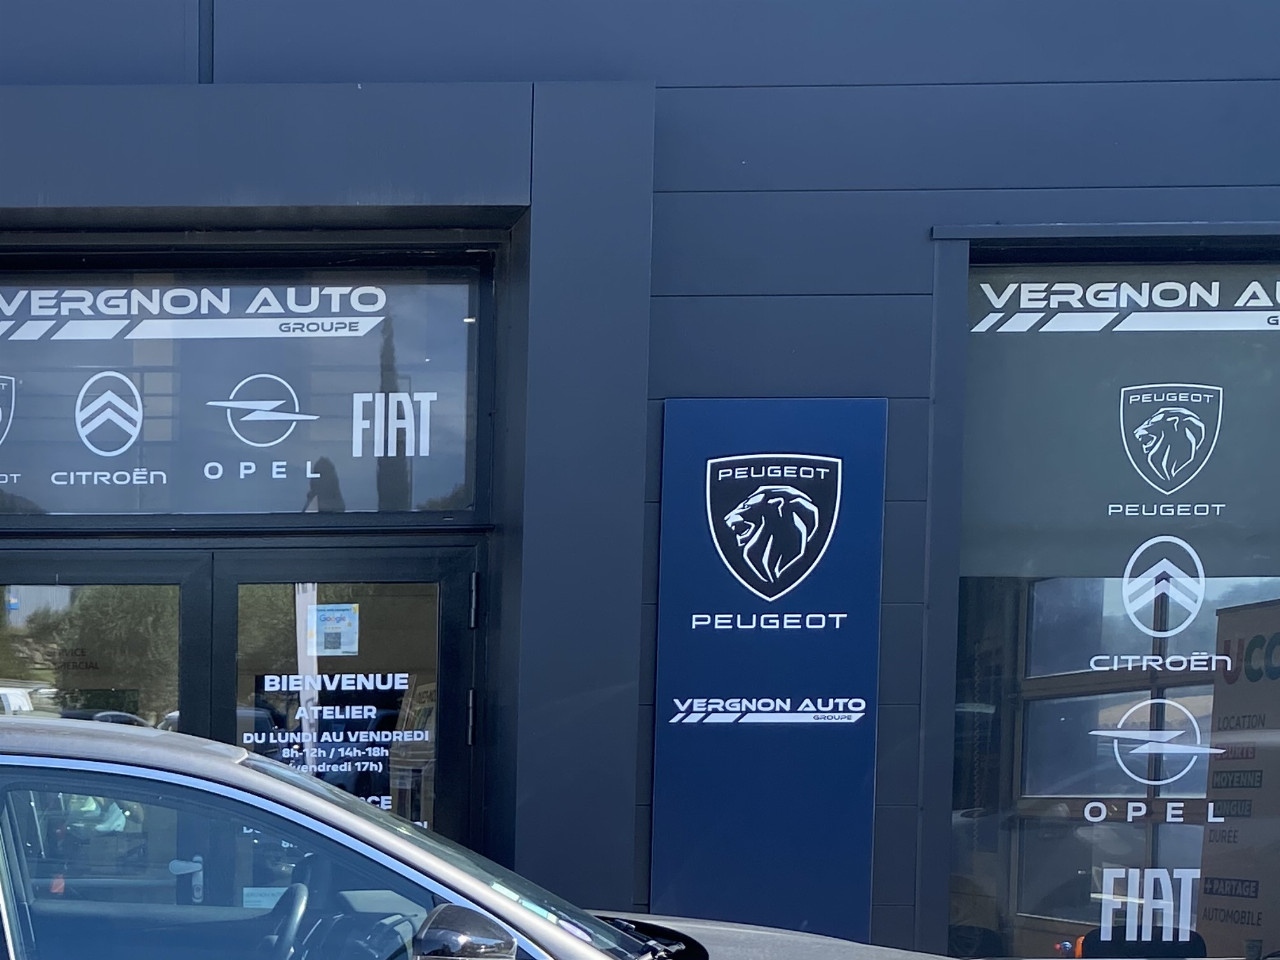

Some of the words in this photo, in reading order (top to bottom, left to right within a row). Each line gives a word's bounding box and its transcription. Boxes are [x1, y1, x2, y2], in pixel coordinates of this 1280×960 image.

[245, 286, 387, 314] AUTO
[979, 281, 1220, 309] VERGNON
[1233, 280, 1280, 307] A
[278, 321, 360, 333] GROUPE
[1129, 392, 1214, 404] PEUGEOT
[352, 392, 438, 458] FIAT
[50, 468, 167, 485] CITROËN
[203, 460, 321, 480] OPEL
[718, 465, 830, 481] PEUGEOT
[1108, 504, 1226, 516] PEUGEOT
[691, 613, 848, 629] PEUGEOT
[1089, 651, 1232, 671] CITROËN
[263, 673, 410, 692] BIENVENUE
[294, 705, 377, 720] ATELIER
[673, 698, 791, 712] VERGNON
[796, 698, 866, 712] AUTO
[1218, 714, 1266, 731] LOCATION
[243, 732, 266, 744] DU
[269, 732, 318, 743] LUNDI
[320, 731, 344, 743] AU
[346, 730, 429, 742] VENDREDI
[281, 747, 327, 758] 8h-12h
[337, 746, 389, 758] 14h-18h
[355, 761, 383, 773] 17h)
[1213, 771, 1261, 788] MOYENNE
[1083, 802, 1225, 823] OPEL
[1213, 800, 1251, 816] ONGUE
[1099, 868, 1201, 942] FIAT
[1202, 907, 1263, 926] AUTOMOBILE
